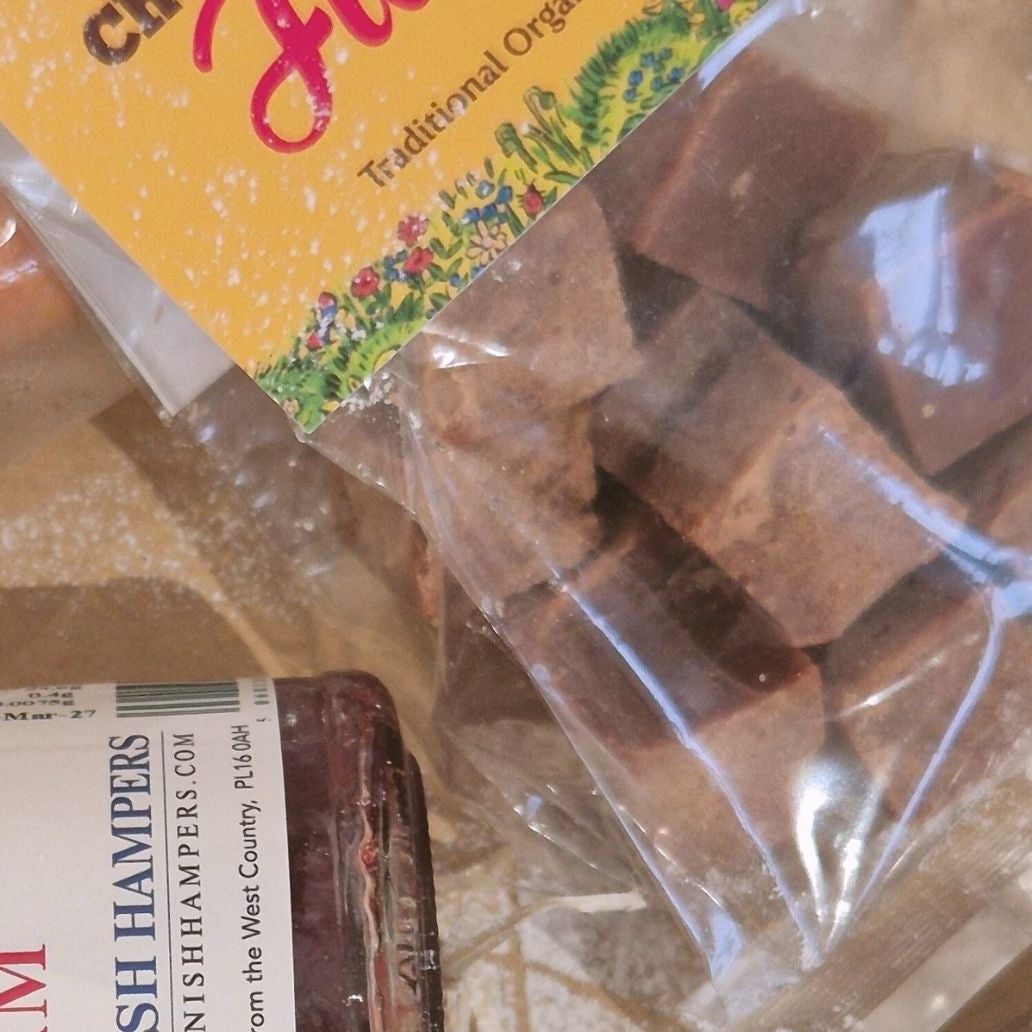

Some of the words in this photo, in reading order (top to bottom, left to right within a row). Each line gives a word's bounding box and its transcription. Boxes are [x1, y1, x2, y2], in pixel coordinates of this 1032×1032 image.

[356, 50, 510, 187] Traditional
[233, 755, 255, 790] PL16
[109, 733, 157, 943] HAMPERS
[238, 799, 263, 880] Country,
[240, 884, 262, 941] West
[242, 946, 264, 984] the
